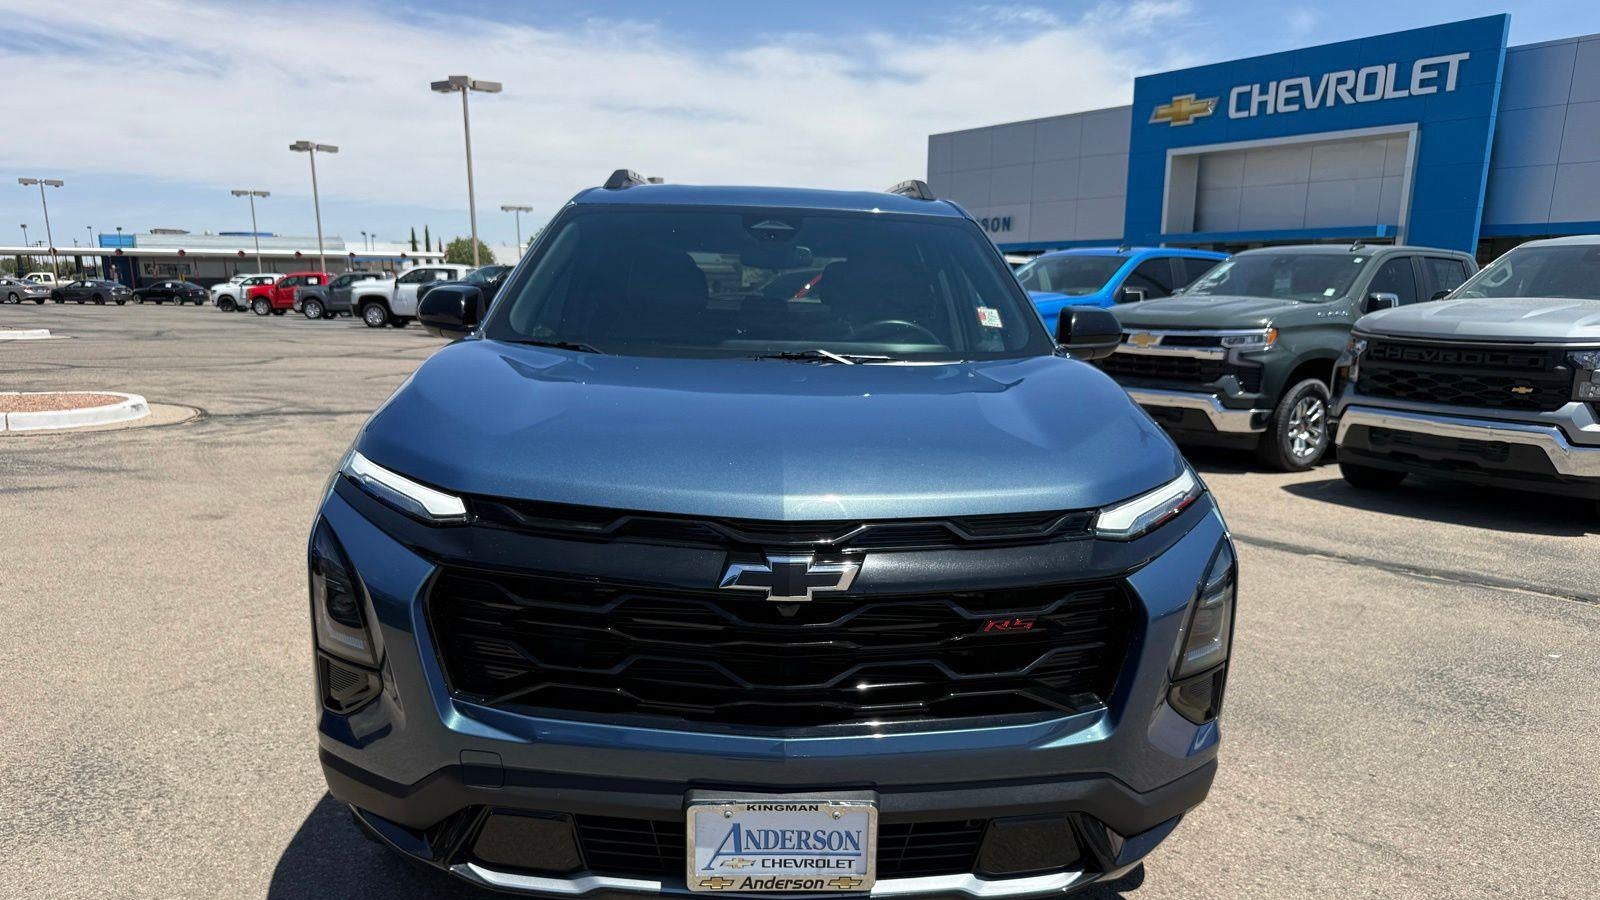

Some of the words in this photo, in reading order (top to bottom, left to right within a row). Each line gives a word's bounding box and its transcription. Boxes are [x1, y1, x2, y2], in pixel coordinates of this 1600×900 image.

[1228, 52, 1470, 119] CHEVROLET
[1371, 343, 1544, 367] CHEVROLET
[983, 618, 1035, 633] RS
[747, 804, 819, 812] KINGMAN
[701, 822, 862, 870] ANDERSON
[761, 858, 855, 869] CHEVROLET
[739, 876, 825, 890] Anderson
